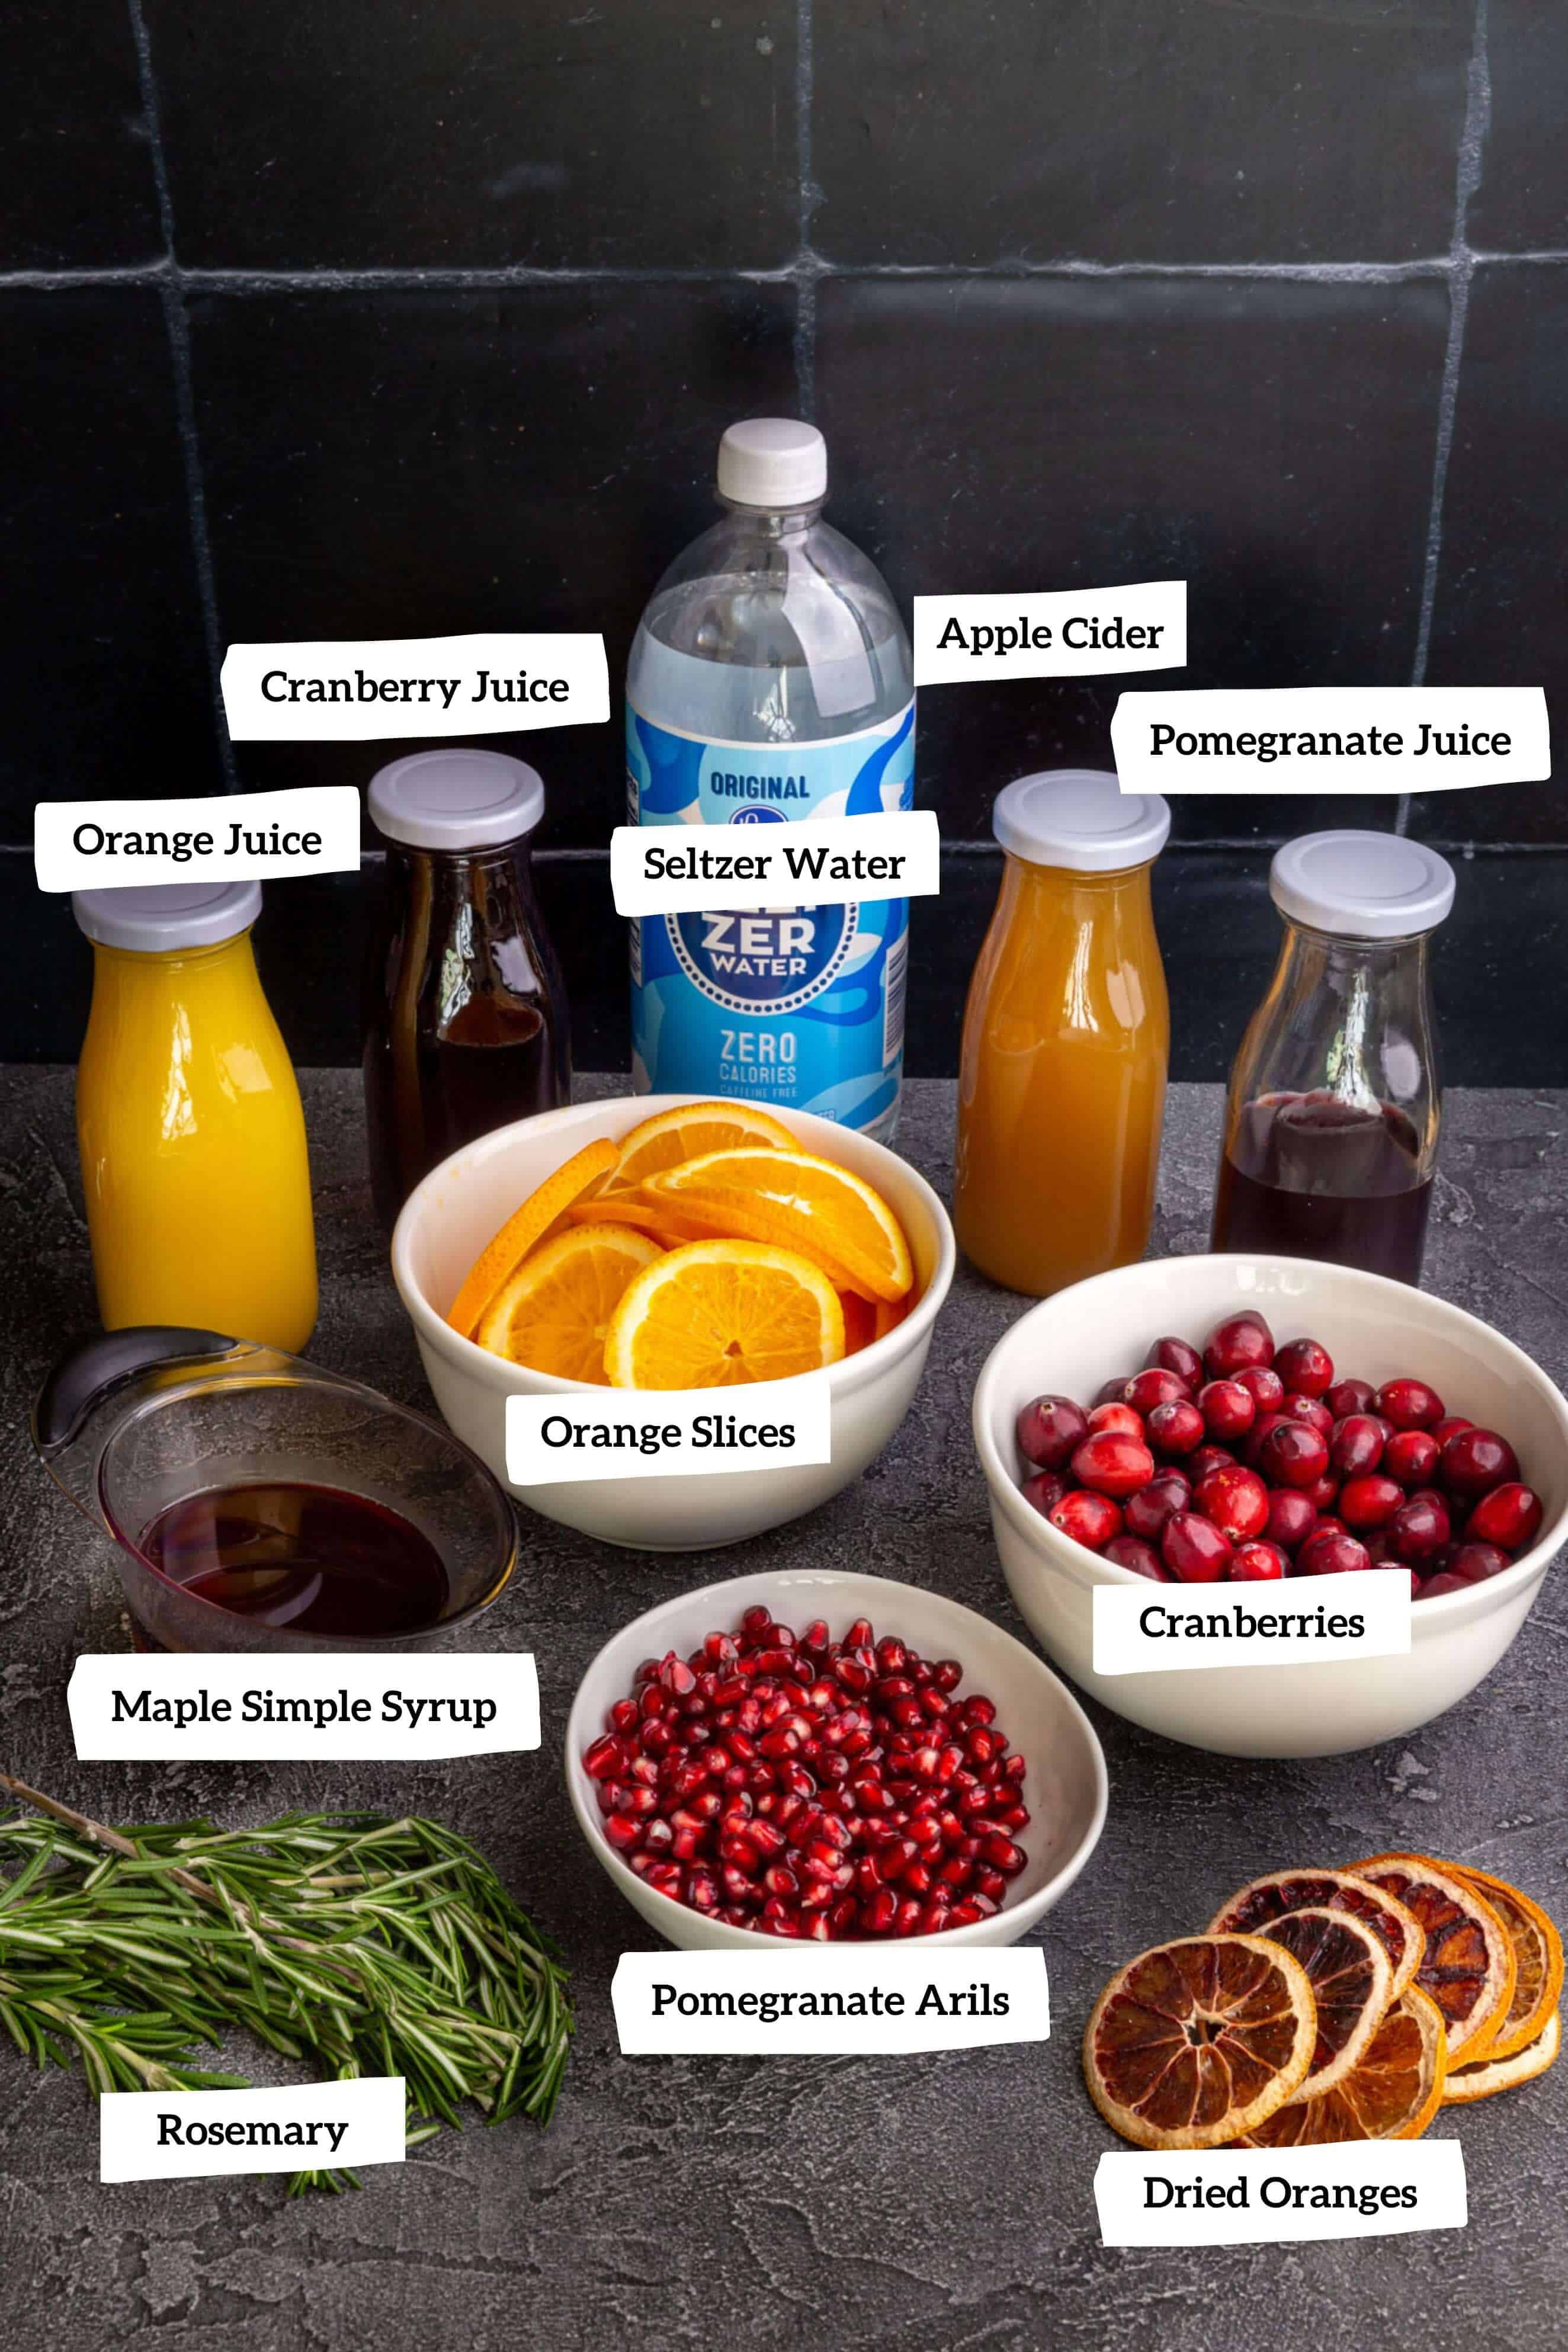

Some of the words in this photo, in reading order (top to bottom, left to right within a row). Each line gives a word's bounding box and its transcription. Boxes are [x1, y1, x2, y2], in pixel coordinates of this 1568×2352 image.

[711, 771, 810, 799] ORIGINAL
[701, 912, 816, 956] ZER
[710, 953, 807, 976] WATER
[720, 1030, 797, 1062] ZERO
[720, 1062, 796, 1084] CALORIES
